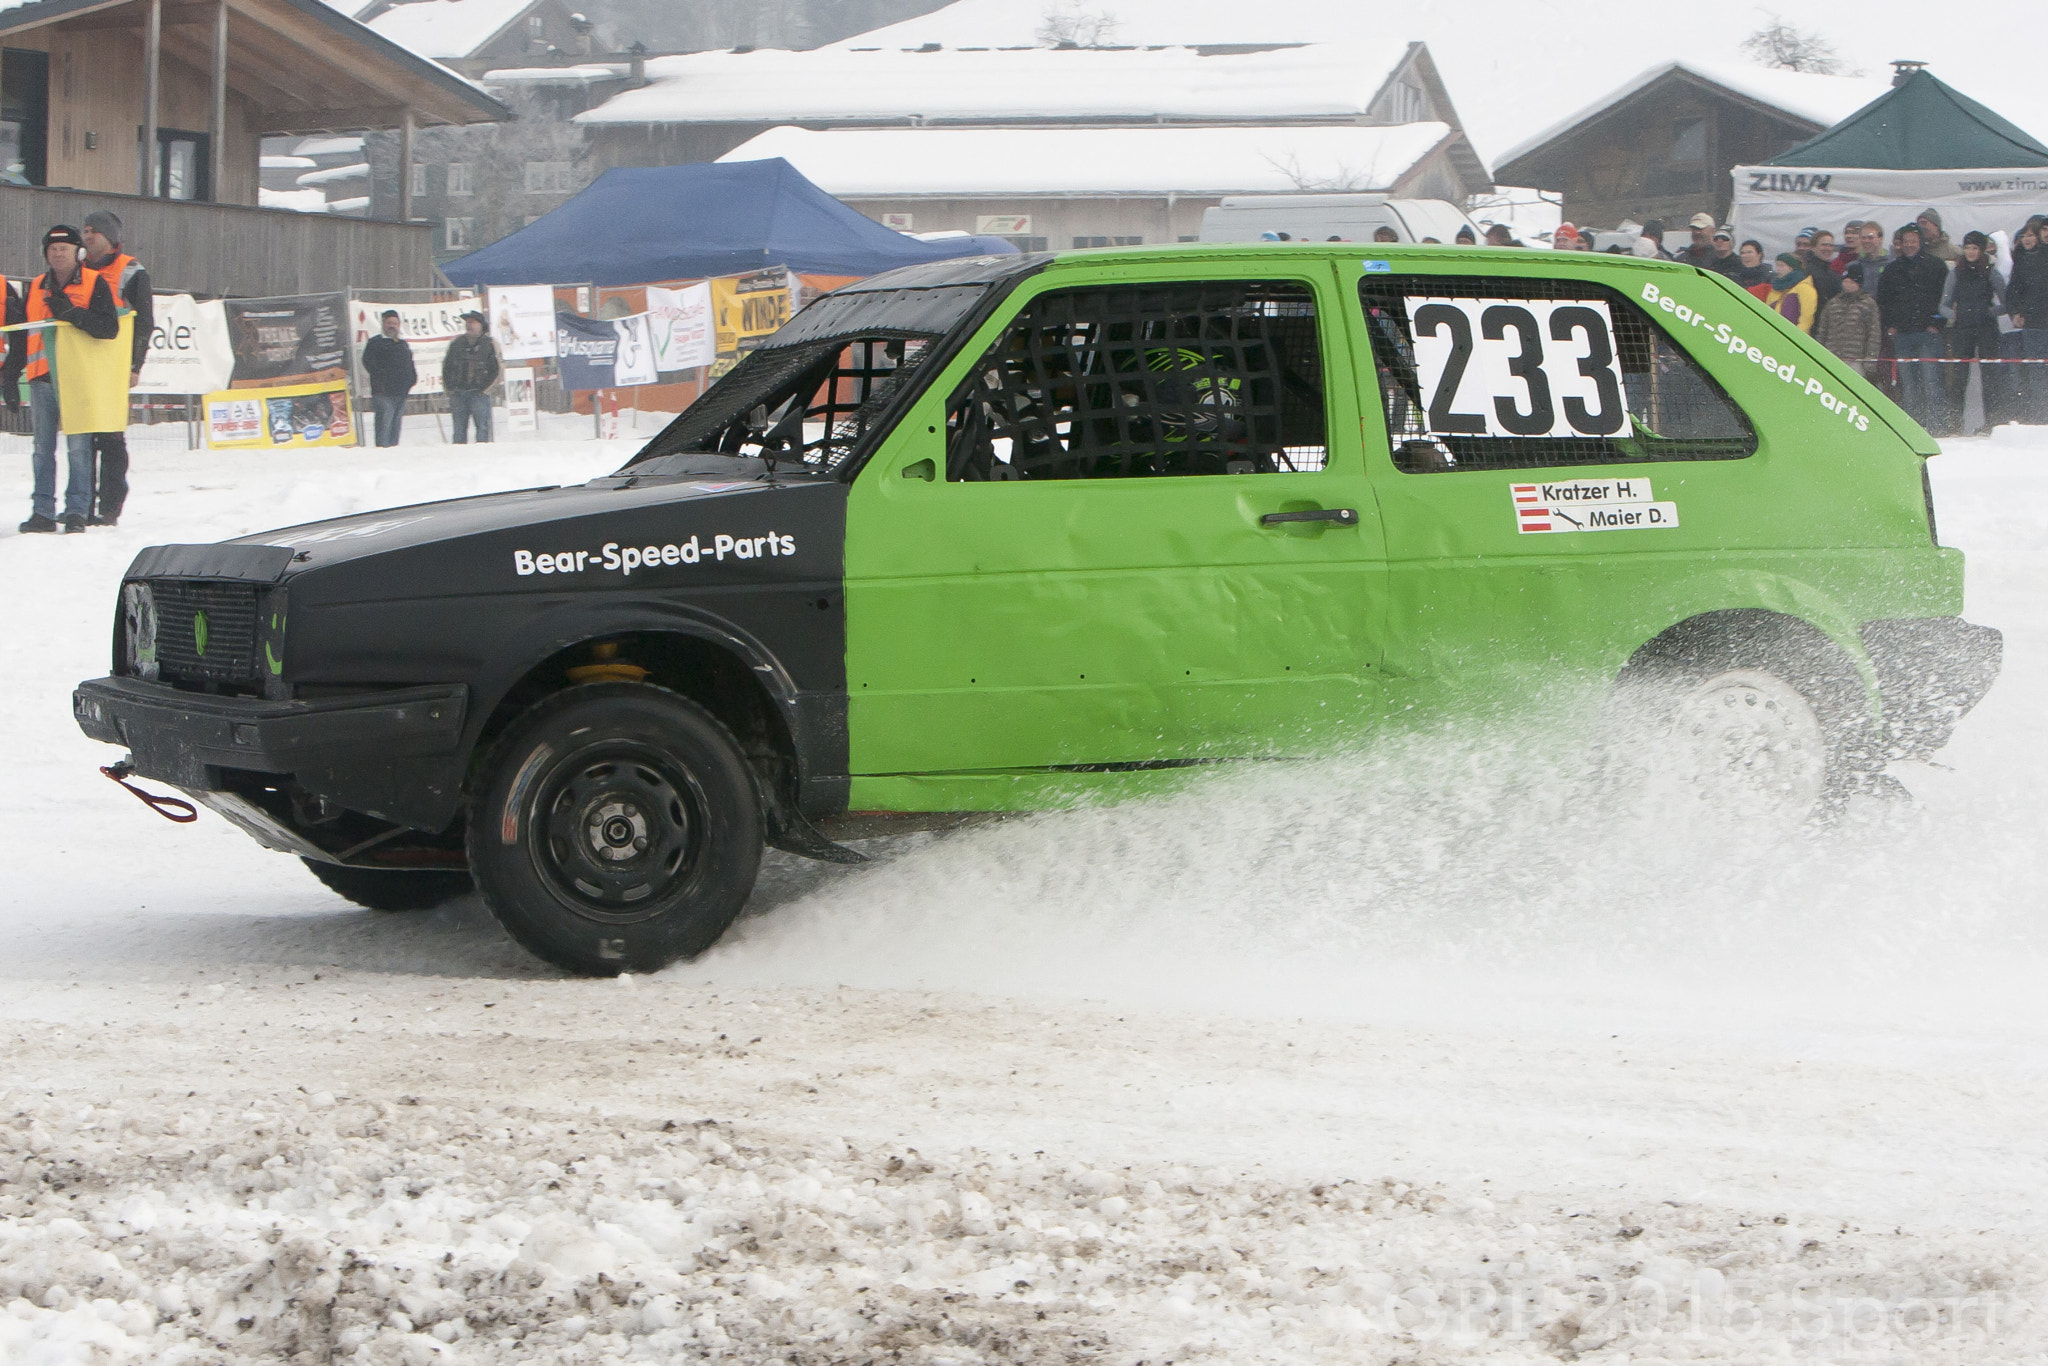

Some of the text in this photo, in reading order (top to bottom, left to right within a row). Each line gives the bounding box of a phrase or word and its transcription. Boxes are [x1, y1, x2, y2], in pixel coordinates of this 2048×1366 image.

[1414, 303, 1622, 435] 233
[1641, 283, 1870, 432] Bear-Speed-Parts
[1542, 481, 1637, 502] Kratzer H.
[1589, 508, 1667, 527] Maier D.
[514, 531, 796, 575] Bear-Speed-Parts
